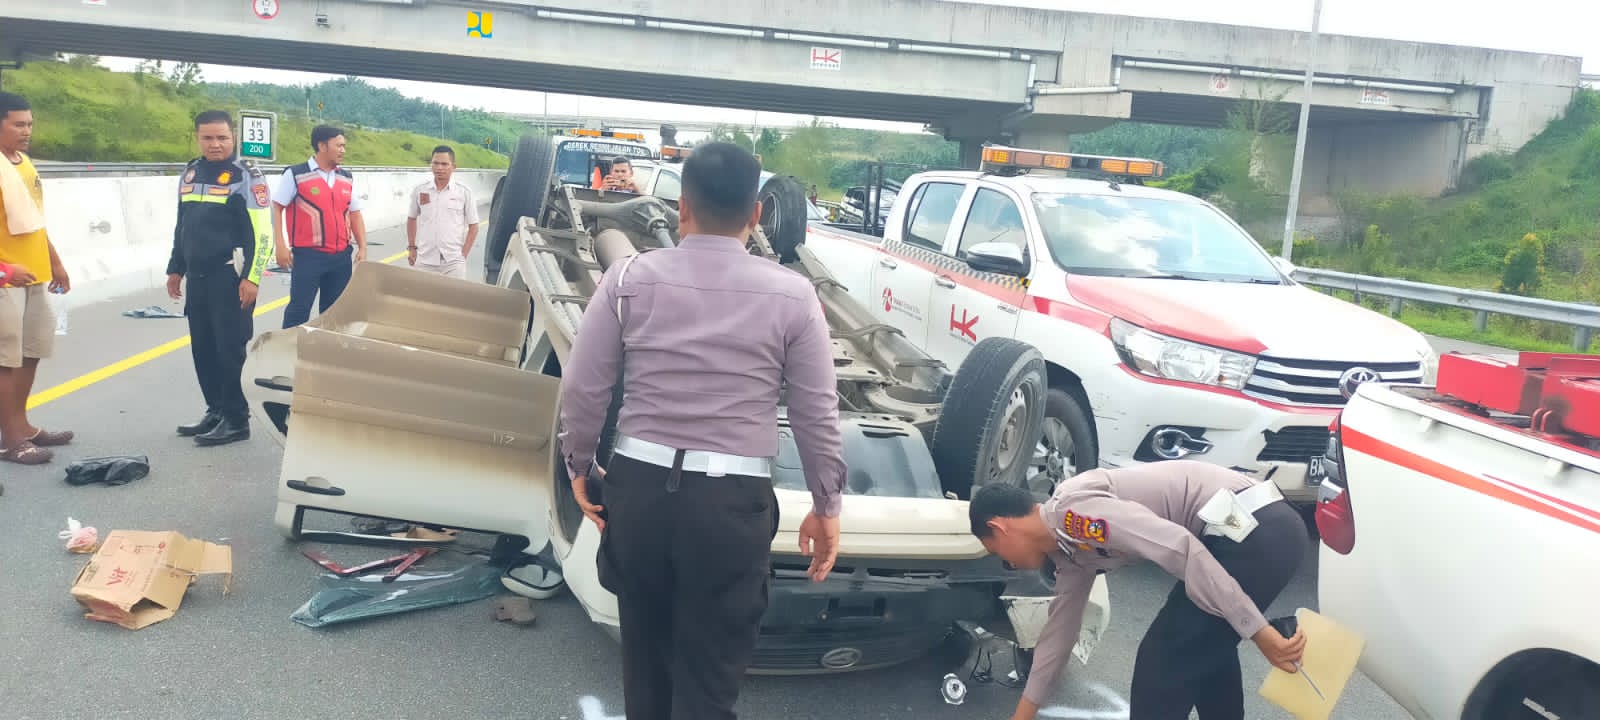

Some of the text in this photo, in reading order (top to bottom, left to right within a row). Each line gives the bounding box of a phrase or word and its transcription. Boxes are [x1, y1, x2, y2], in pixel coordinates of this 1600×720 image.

[251, 119, 262, 128] KM
[249, 128, 264, 141] 33
[249, 144, 264, 153] 200
